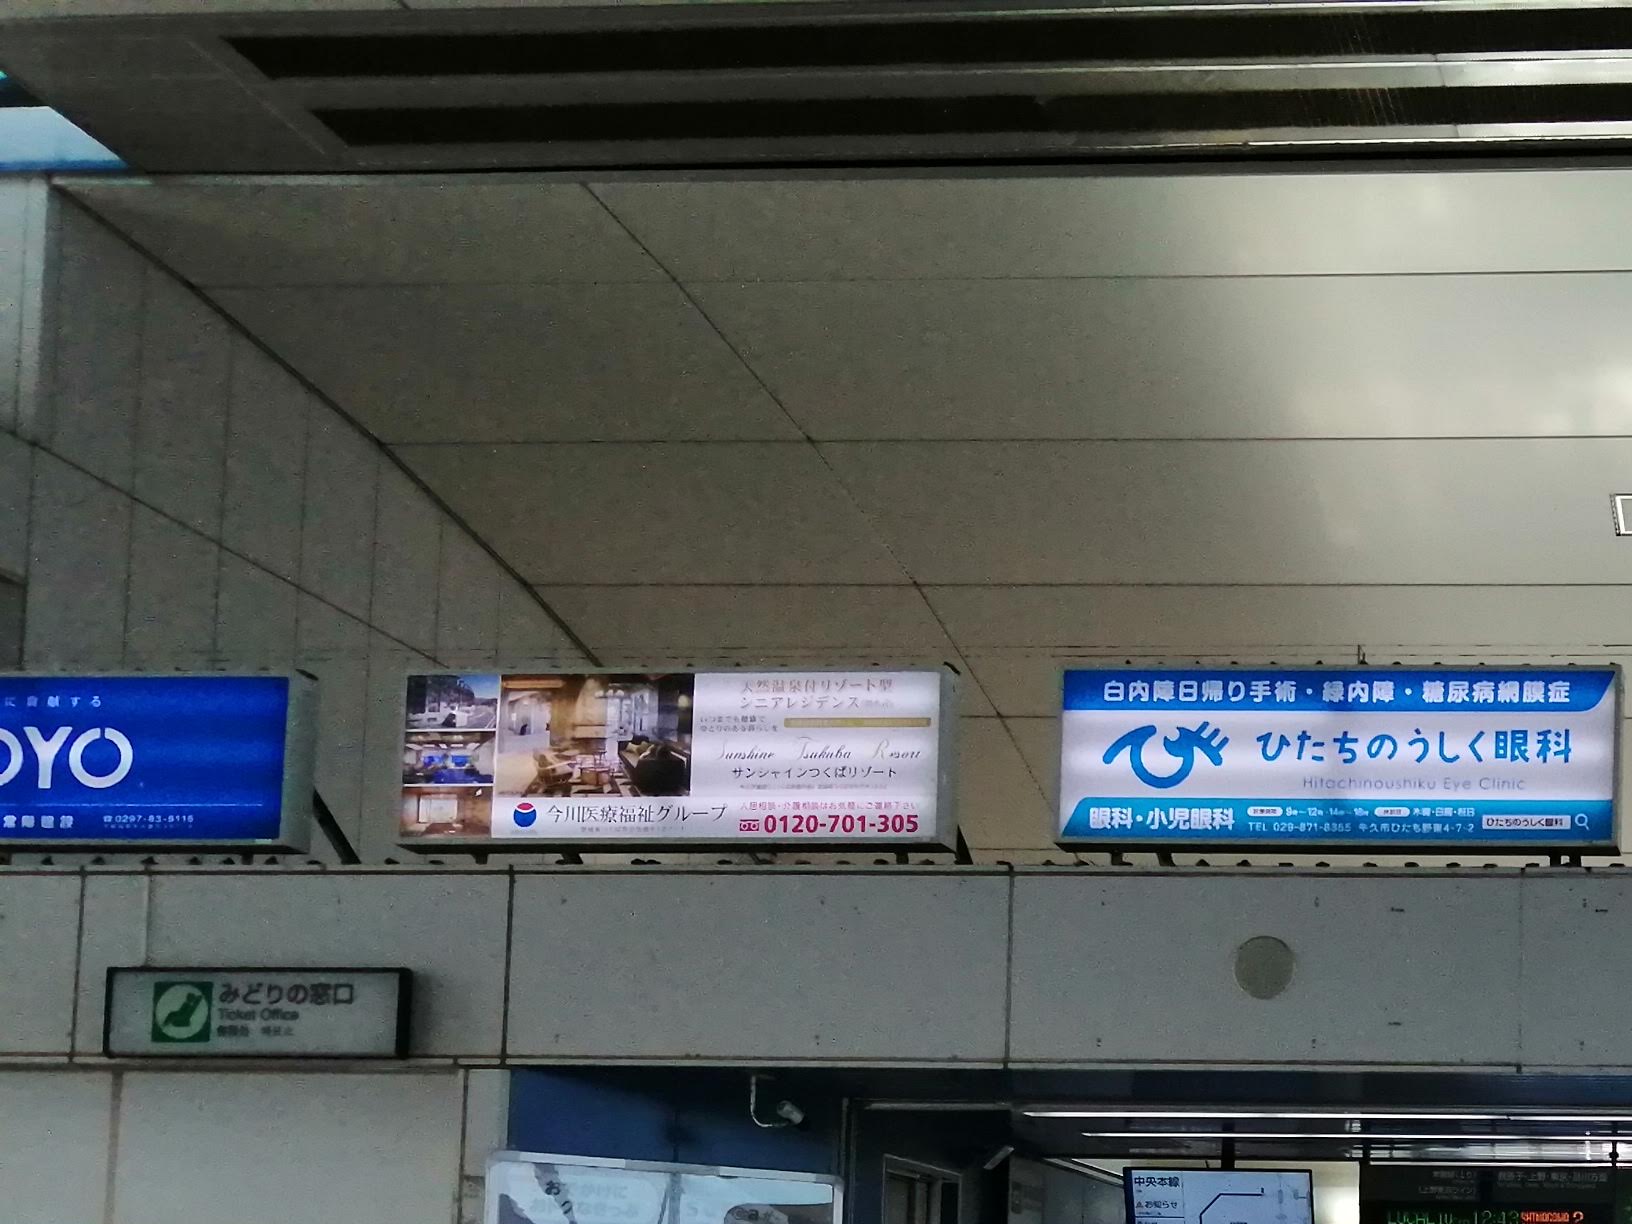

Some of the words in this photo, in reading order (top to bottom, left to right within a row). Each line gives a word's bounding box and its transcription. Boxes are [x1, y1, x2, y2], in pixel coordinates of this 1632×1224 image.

[1103, 680, 1571, 703] 白内障日帰り手術・緑内障・糖尿病網膜症
[1256, 728, 1572, 764] ひたちのうしく眼科
[731, 766, 898, 779] サンシャインつくばリゾート
[1443, 777, 1471, 793] Eye
[1479, 776, 1525, 790] Clinic
[546, 804, 729, 824] 今川医療福祉グループ
[764, 814, 919, 833] 0120-701-305
[1089, 807, 1236, 831] 眼科・小児眼科
[1486, 817, 1563, 828] ひたちのうしく眼科
[1248, 822, 1268, 831] TEL
[217, 982, 355, 1006] みどりの窓口
[217, 1008, 256, 1022] Ticket
[259, 1008, 300, 1022] Office
